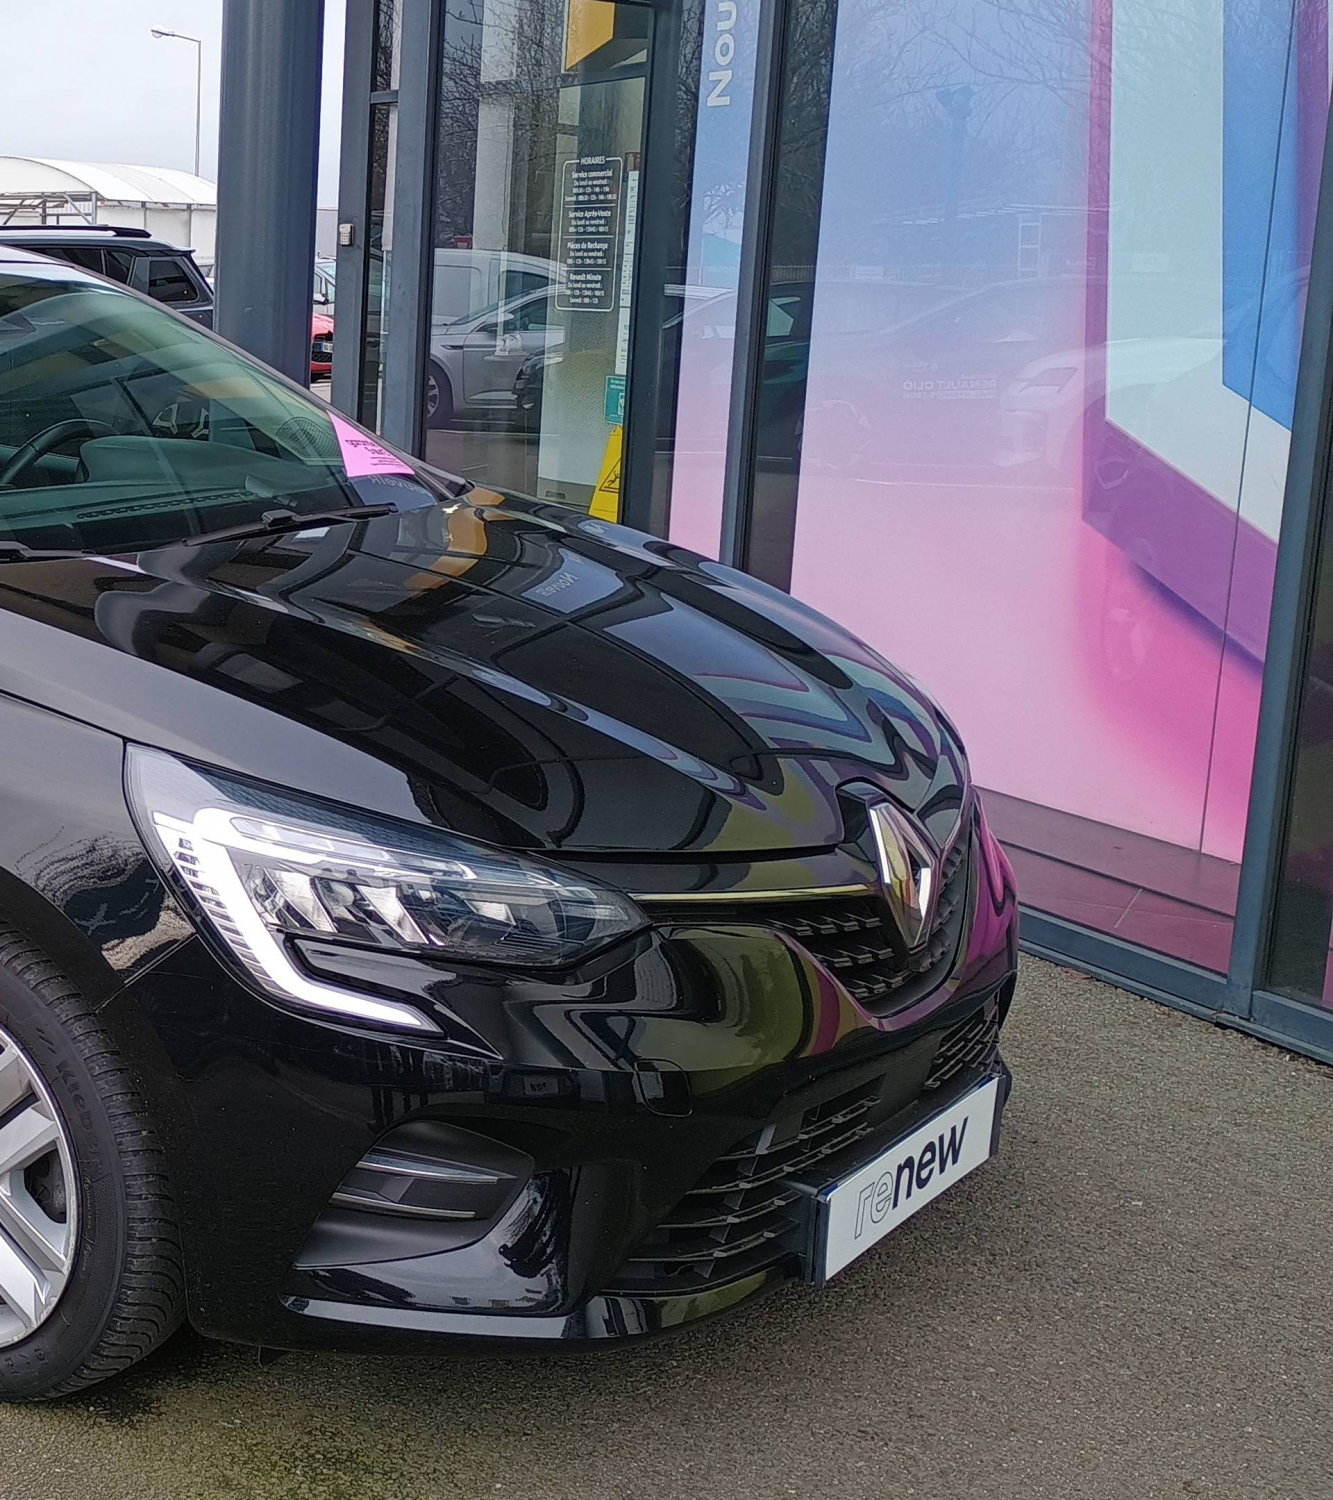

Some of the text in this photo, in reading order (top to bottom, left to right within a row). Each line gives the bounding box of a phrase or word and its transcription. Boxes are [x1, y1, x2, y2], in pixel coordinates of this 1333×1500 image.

[707, 0, 737, 107] Nou
[580, 156, 606, 165] HORAIRES
[571, 168, 613, 178] Service commercial
[568, 209, 612, 219] Service Après-Vente
[587, 241, 608, 250] Rechange
[569, 272, 602, 281] Renault Minute
[854, 1115, 970, 1240] renew
